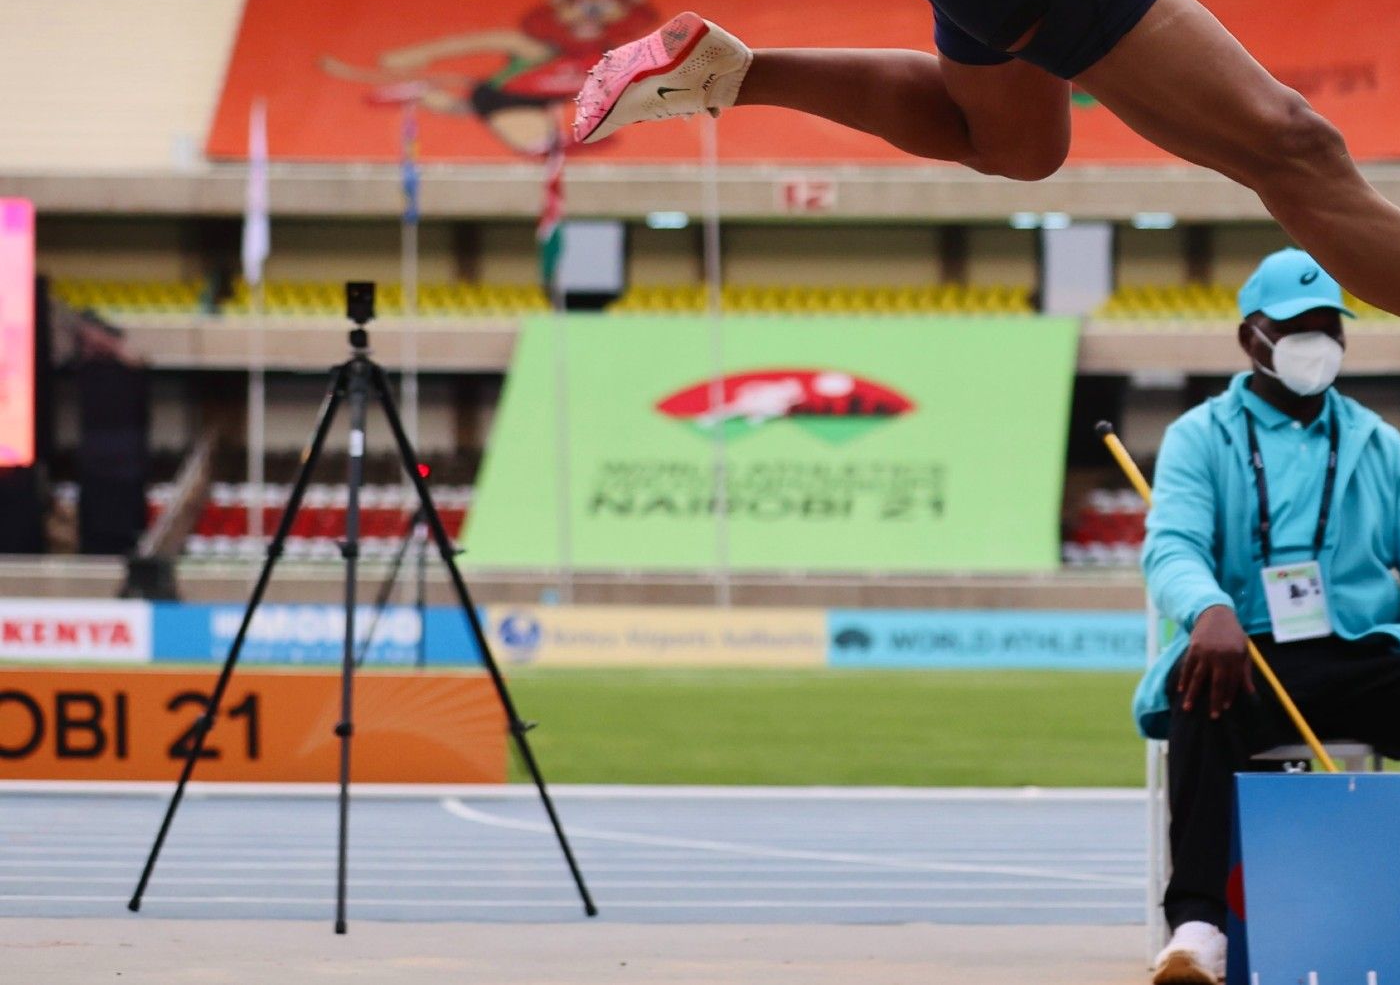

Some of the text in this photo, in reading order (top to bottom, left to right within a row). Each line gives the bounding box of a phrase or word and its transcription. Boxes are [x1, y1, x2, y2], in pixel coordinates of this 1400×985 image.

[586, 491, 948, 521] NAIROBI 21
[2, 622, 134, 645] KENYA
[889, 628, 992, 656] WORLD
[0, 690, 262, 760] OBI 21
